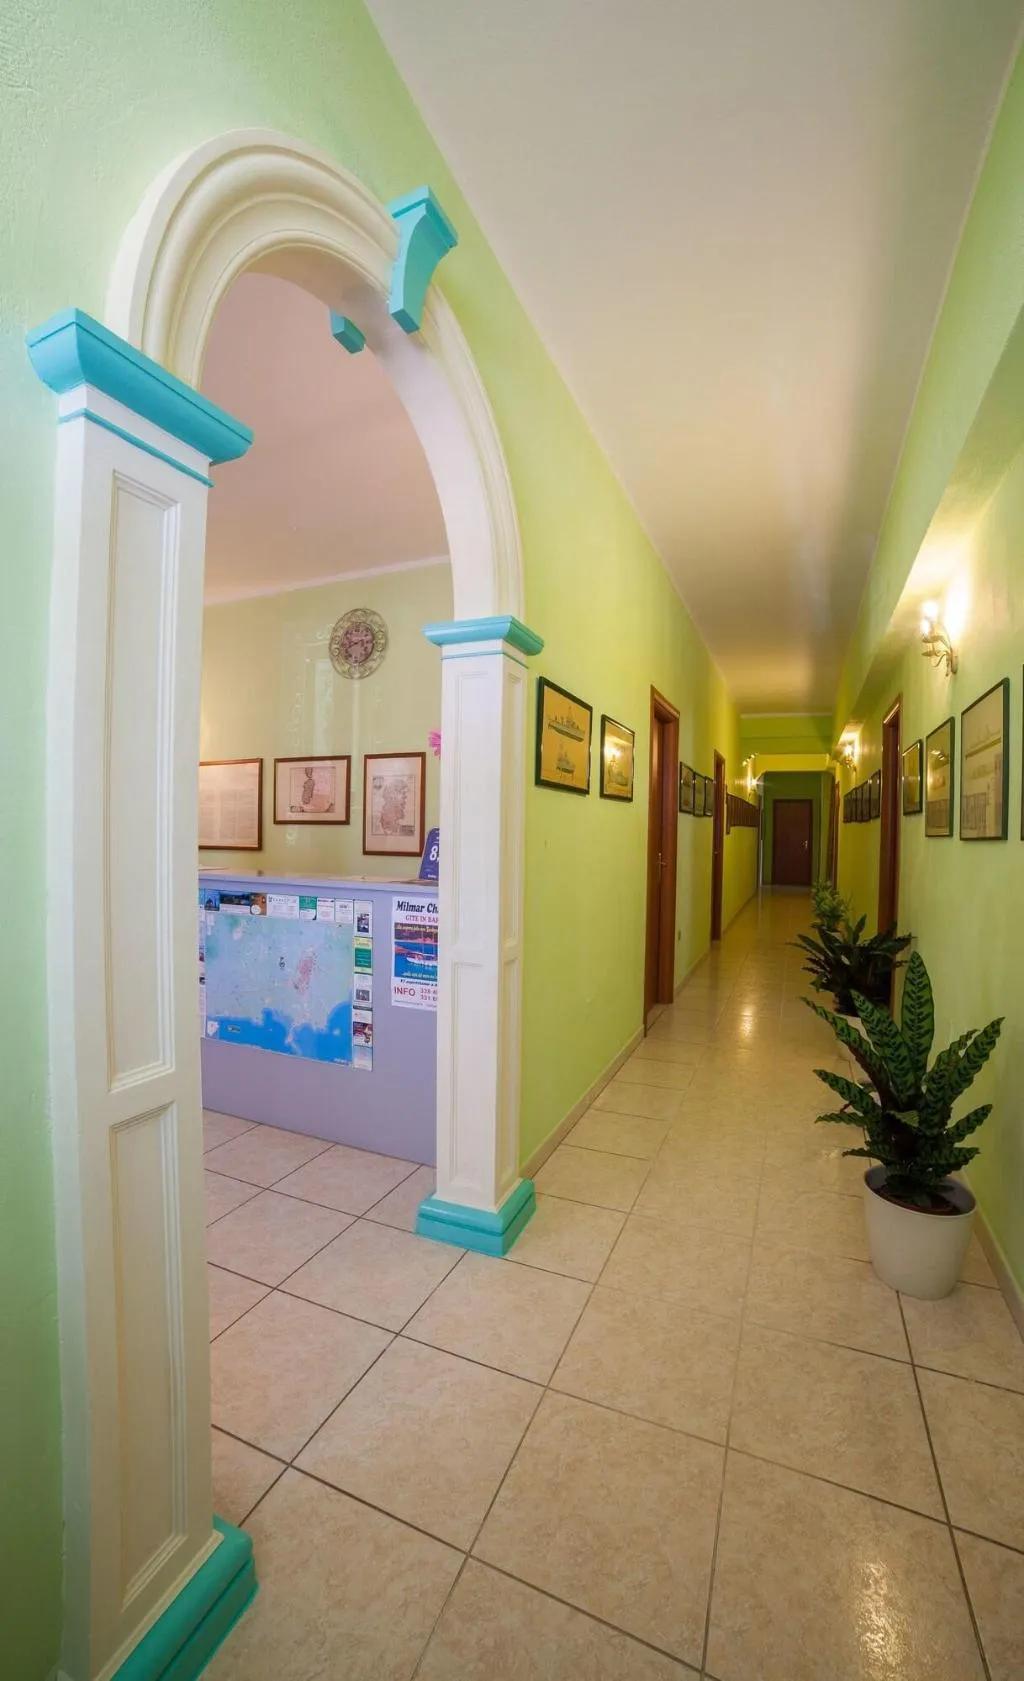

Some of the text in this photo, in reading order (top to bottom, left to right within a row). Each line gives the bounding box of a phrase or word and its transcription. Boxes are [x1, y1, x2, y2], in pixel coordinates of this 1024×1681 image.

[430, 846, 439, 862] 8,
[396, 900, 439, 913] Milmar Ch
[394, 986, 416, 996] INFO
